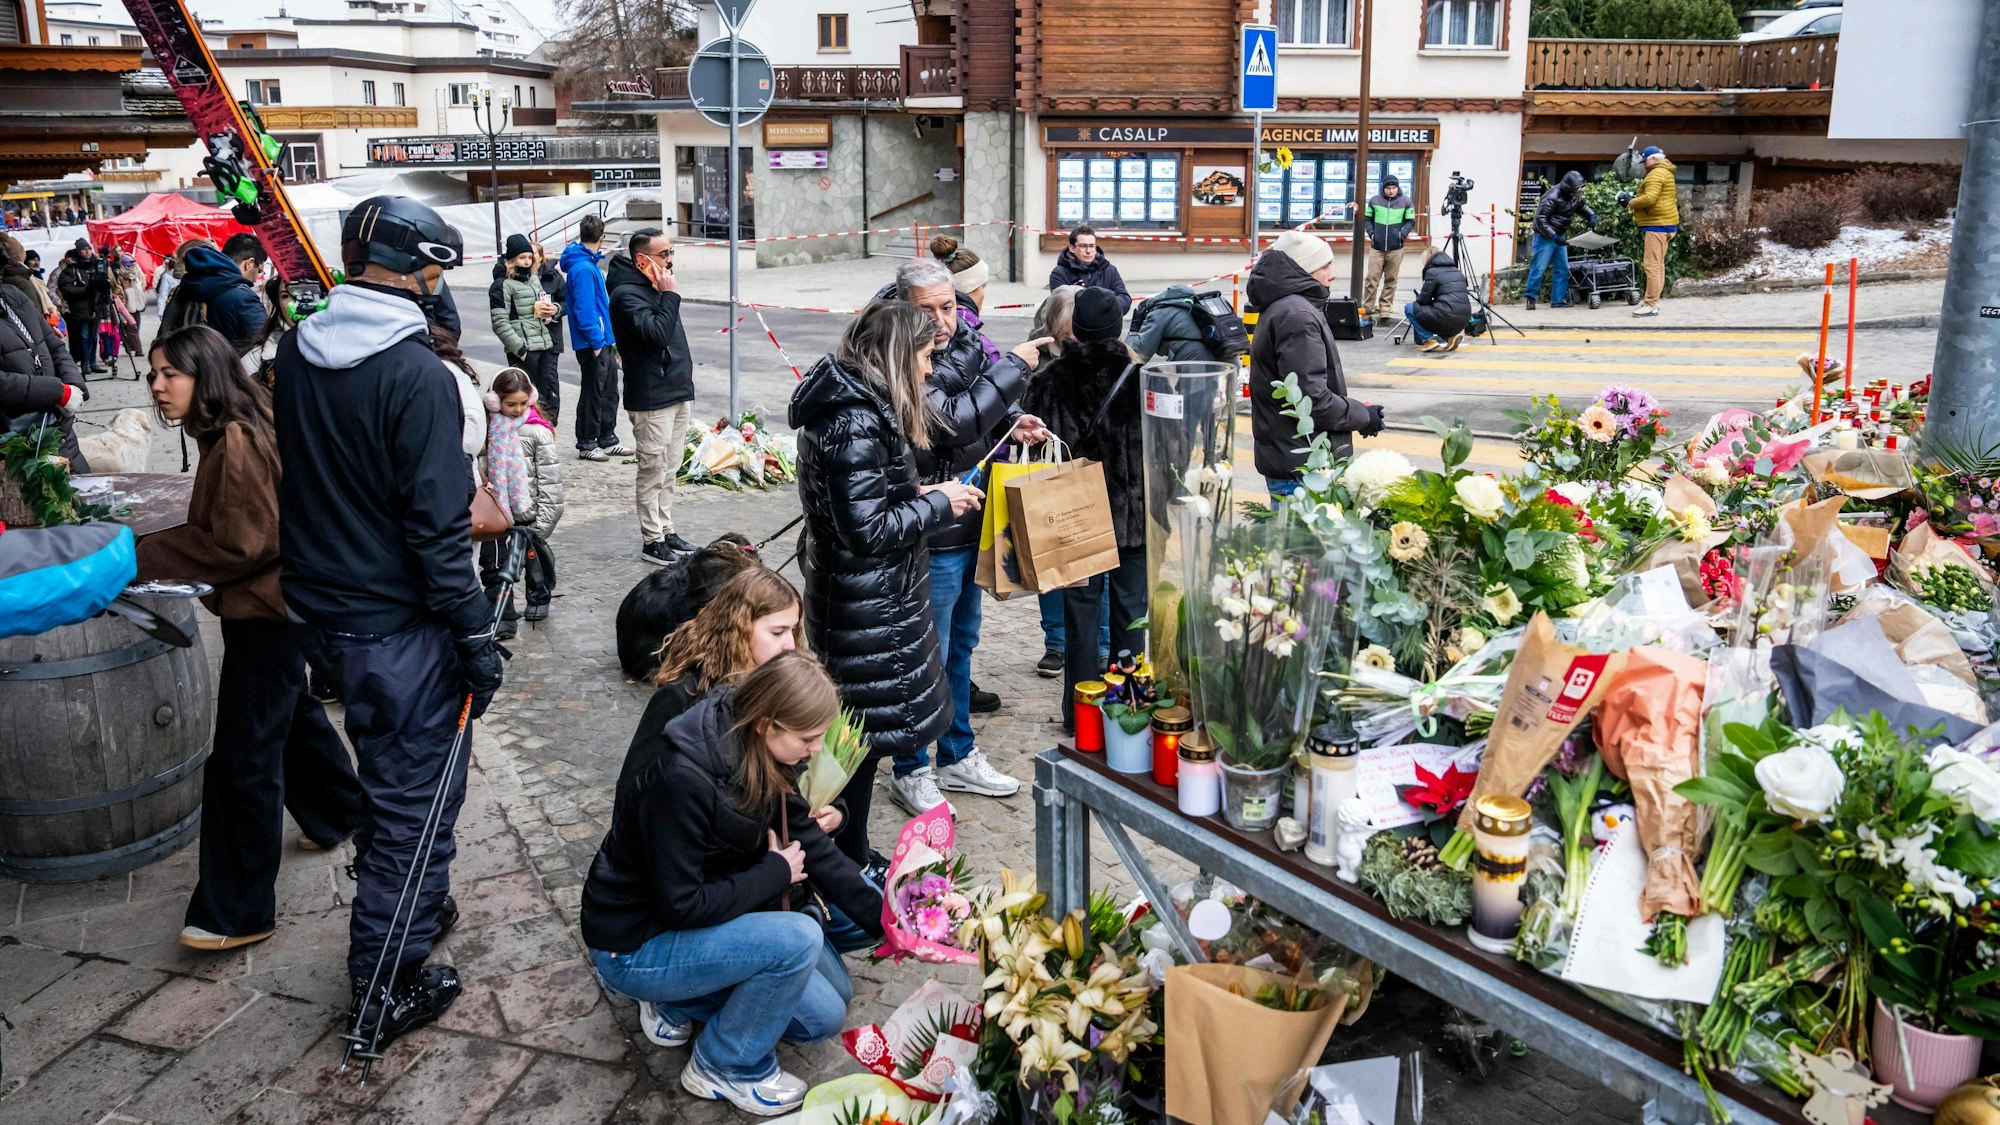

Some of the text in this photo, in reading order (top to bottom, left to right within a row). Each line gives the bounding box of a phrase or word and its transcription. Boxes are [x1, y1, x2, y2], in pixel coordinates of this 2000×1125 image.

[1099, 127, 1168, 141] CASALP
[1261, 128, 1429, 143] AGENCE IMMBILIERE
[408, 144, 434, 154] rental
